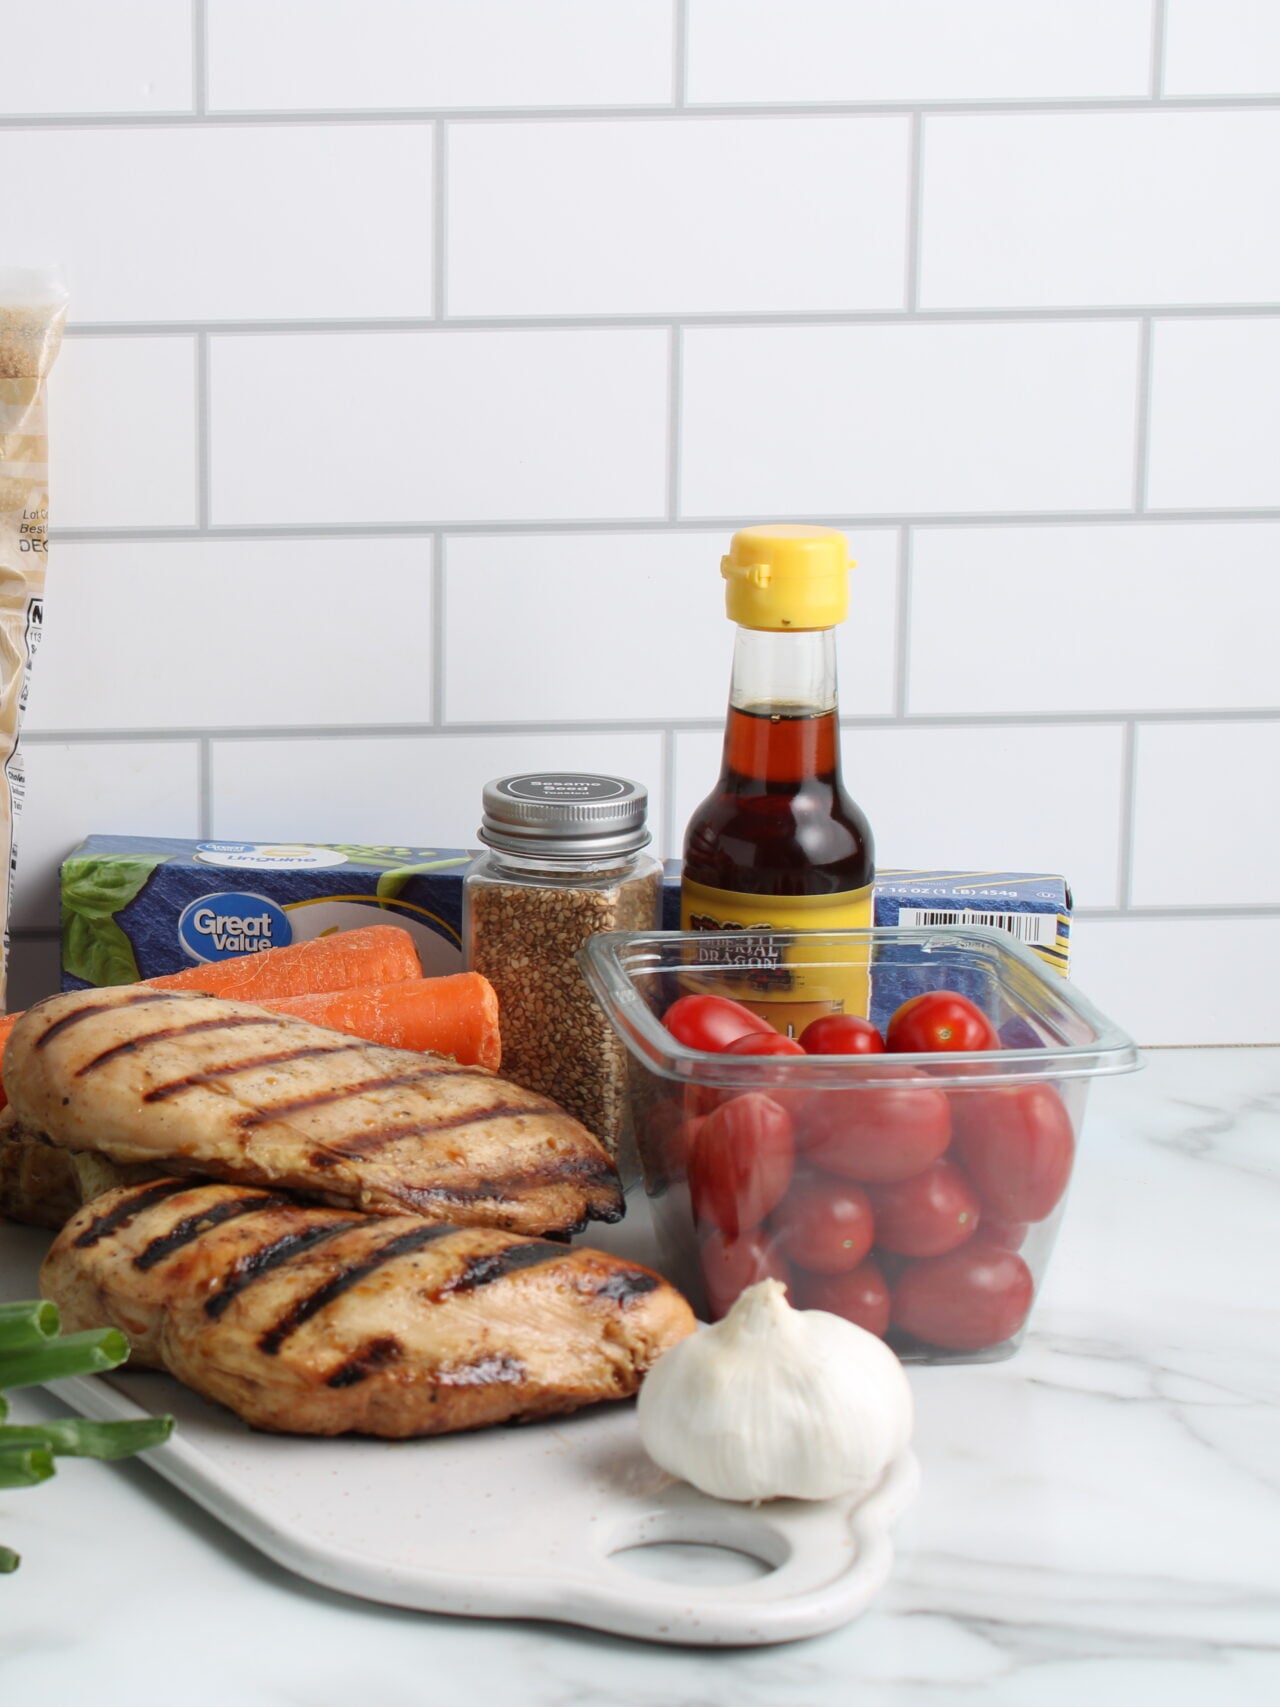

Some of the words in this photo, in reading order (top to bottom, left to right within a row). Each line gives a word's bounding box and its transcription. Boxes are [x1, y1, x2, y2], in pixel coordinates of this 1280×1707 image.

[19, 523, 46, 533] Best
[228, 855, 317, 863] Linguine
[979, 889, 1018, 897] 454g
[194, 908, 272, 937] Great
[212, 933, 273, 952] Value
